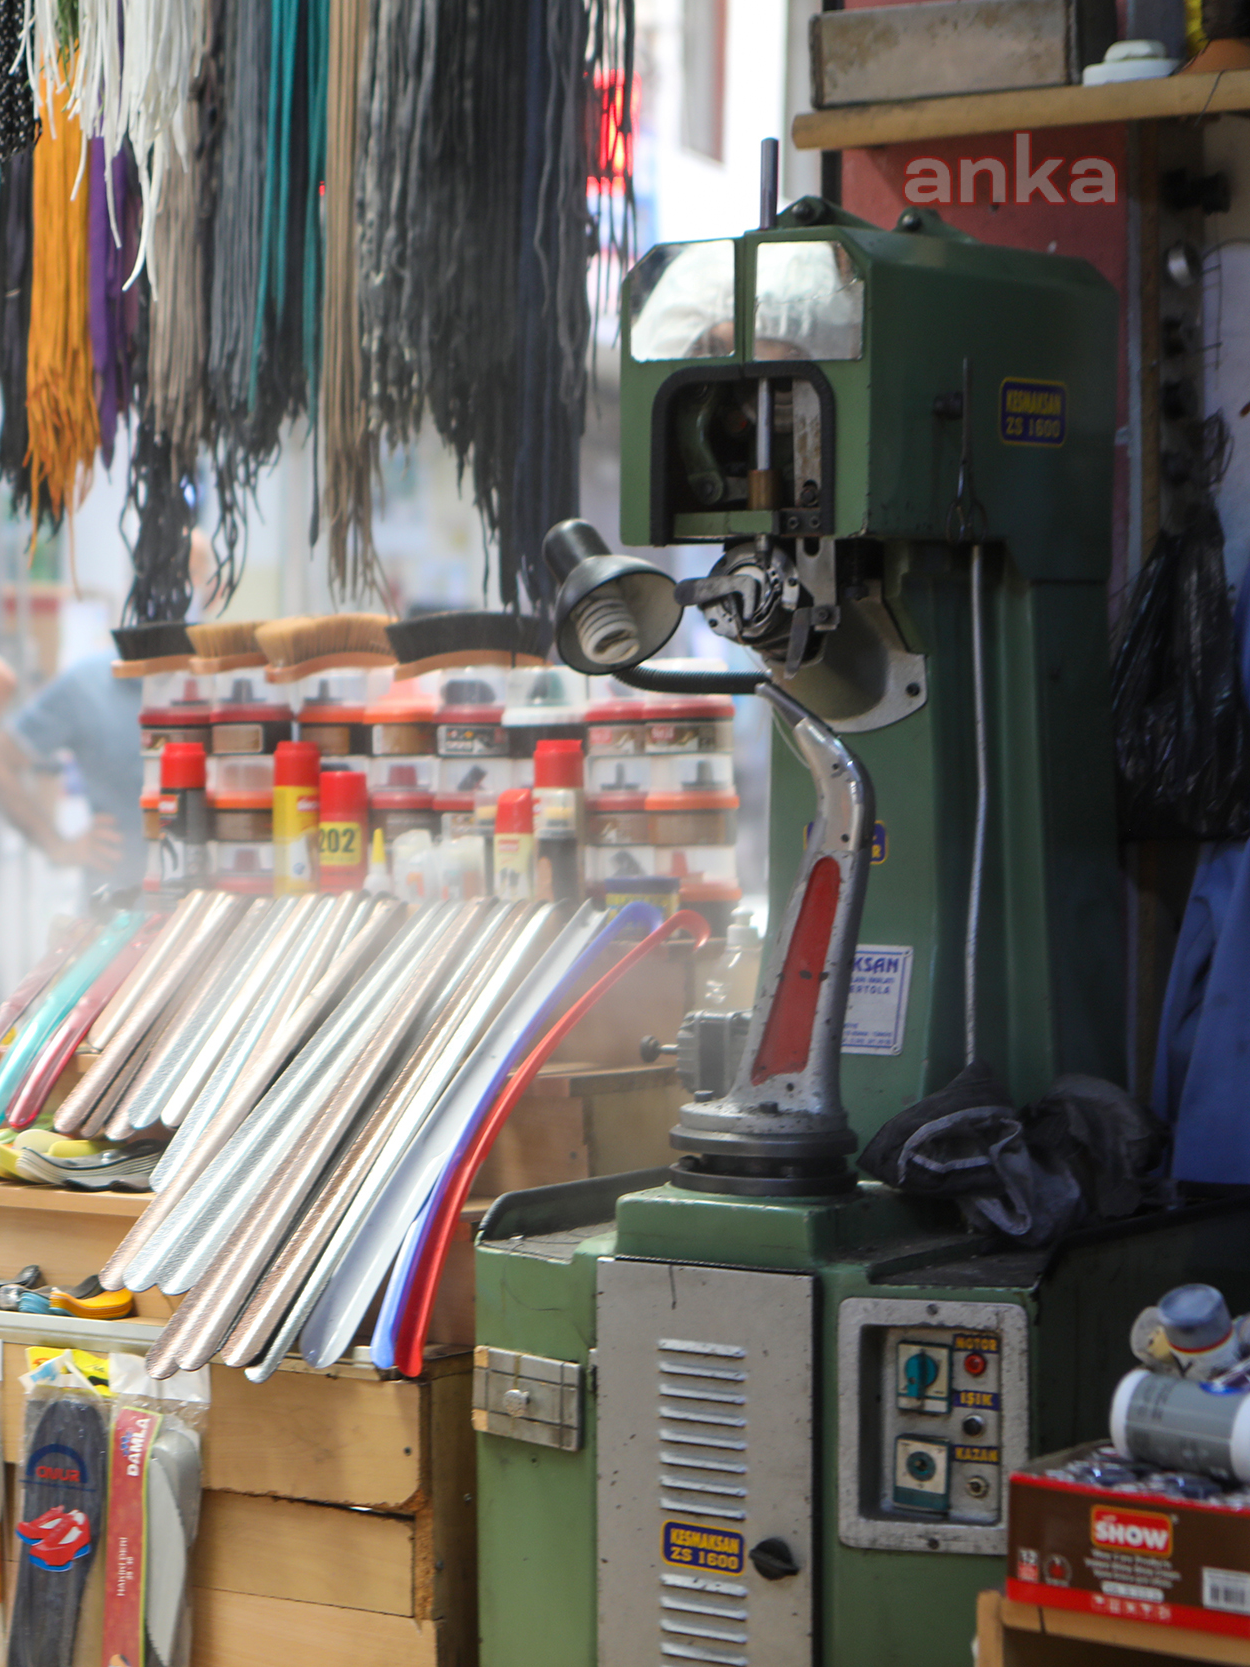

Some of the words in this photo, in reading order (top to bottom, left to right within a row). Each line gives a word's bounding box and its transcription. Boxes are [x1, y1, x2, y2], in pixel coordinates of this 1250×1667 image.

[1006, 416, 1023, 436] ZS
[954, 1336, 998, 1351] MOTOR
[960, 1391, 993, 1408] IŞIK
[126, 1418, 151, 1477] DAMLA
[955, 1447, 998, 1463] KAZAN
[670, 1528, 740, 1554] KESMAKSAN
[1094, 1520, 1169, 1550] SHOW
[671, 1546, 693, 1562] ZS
[698, 1550, 739, 1570] 1600
